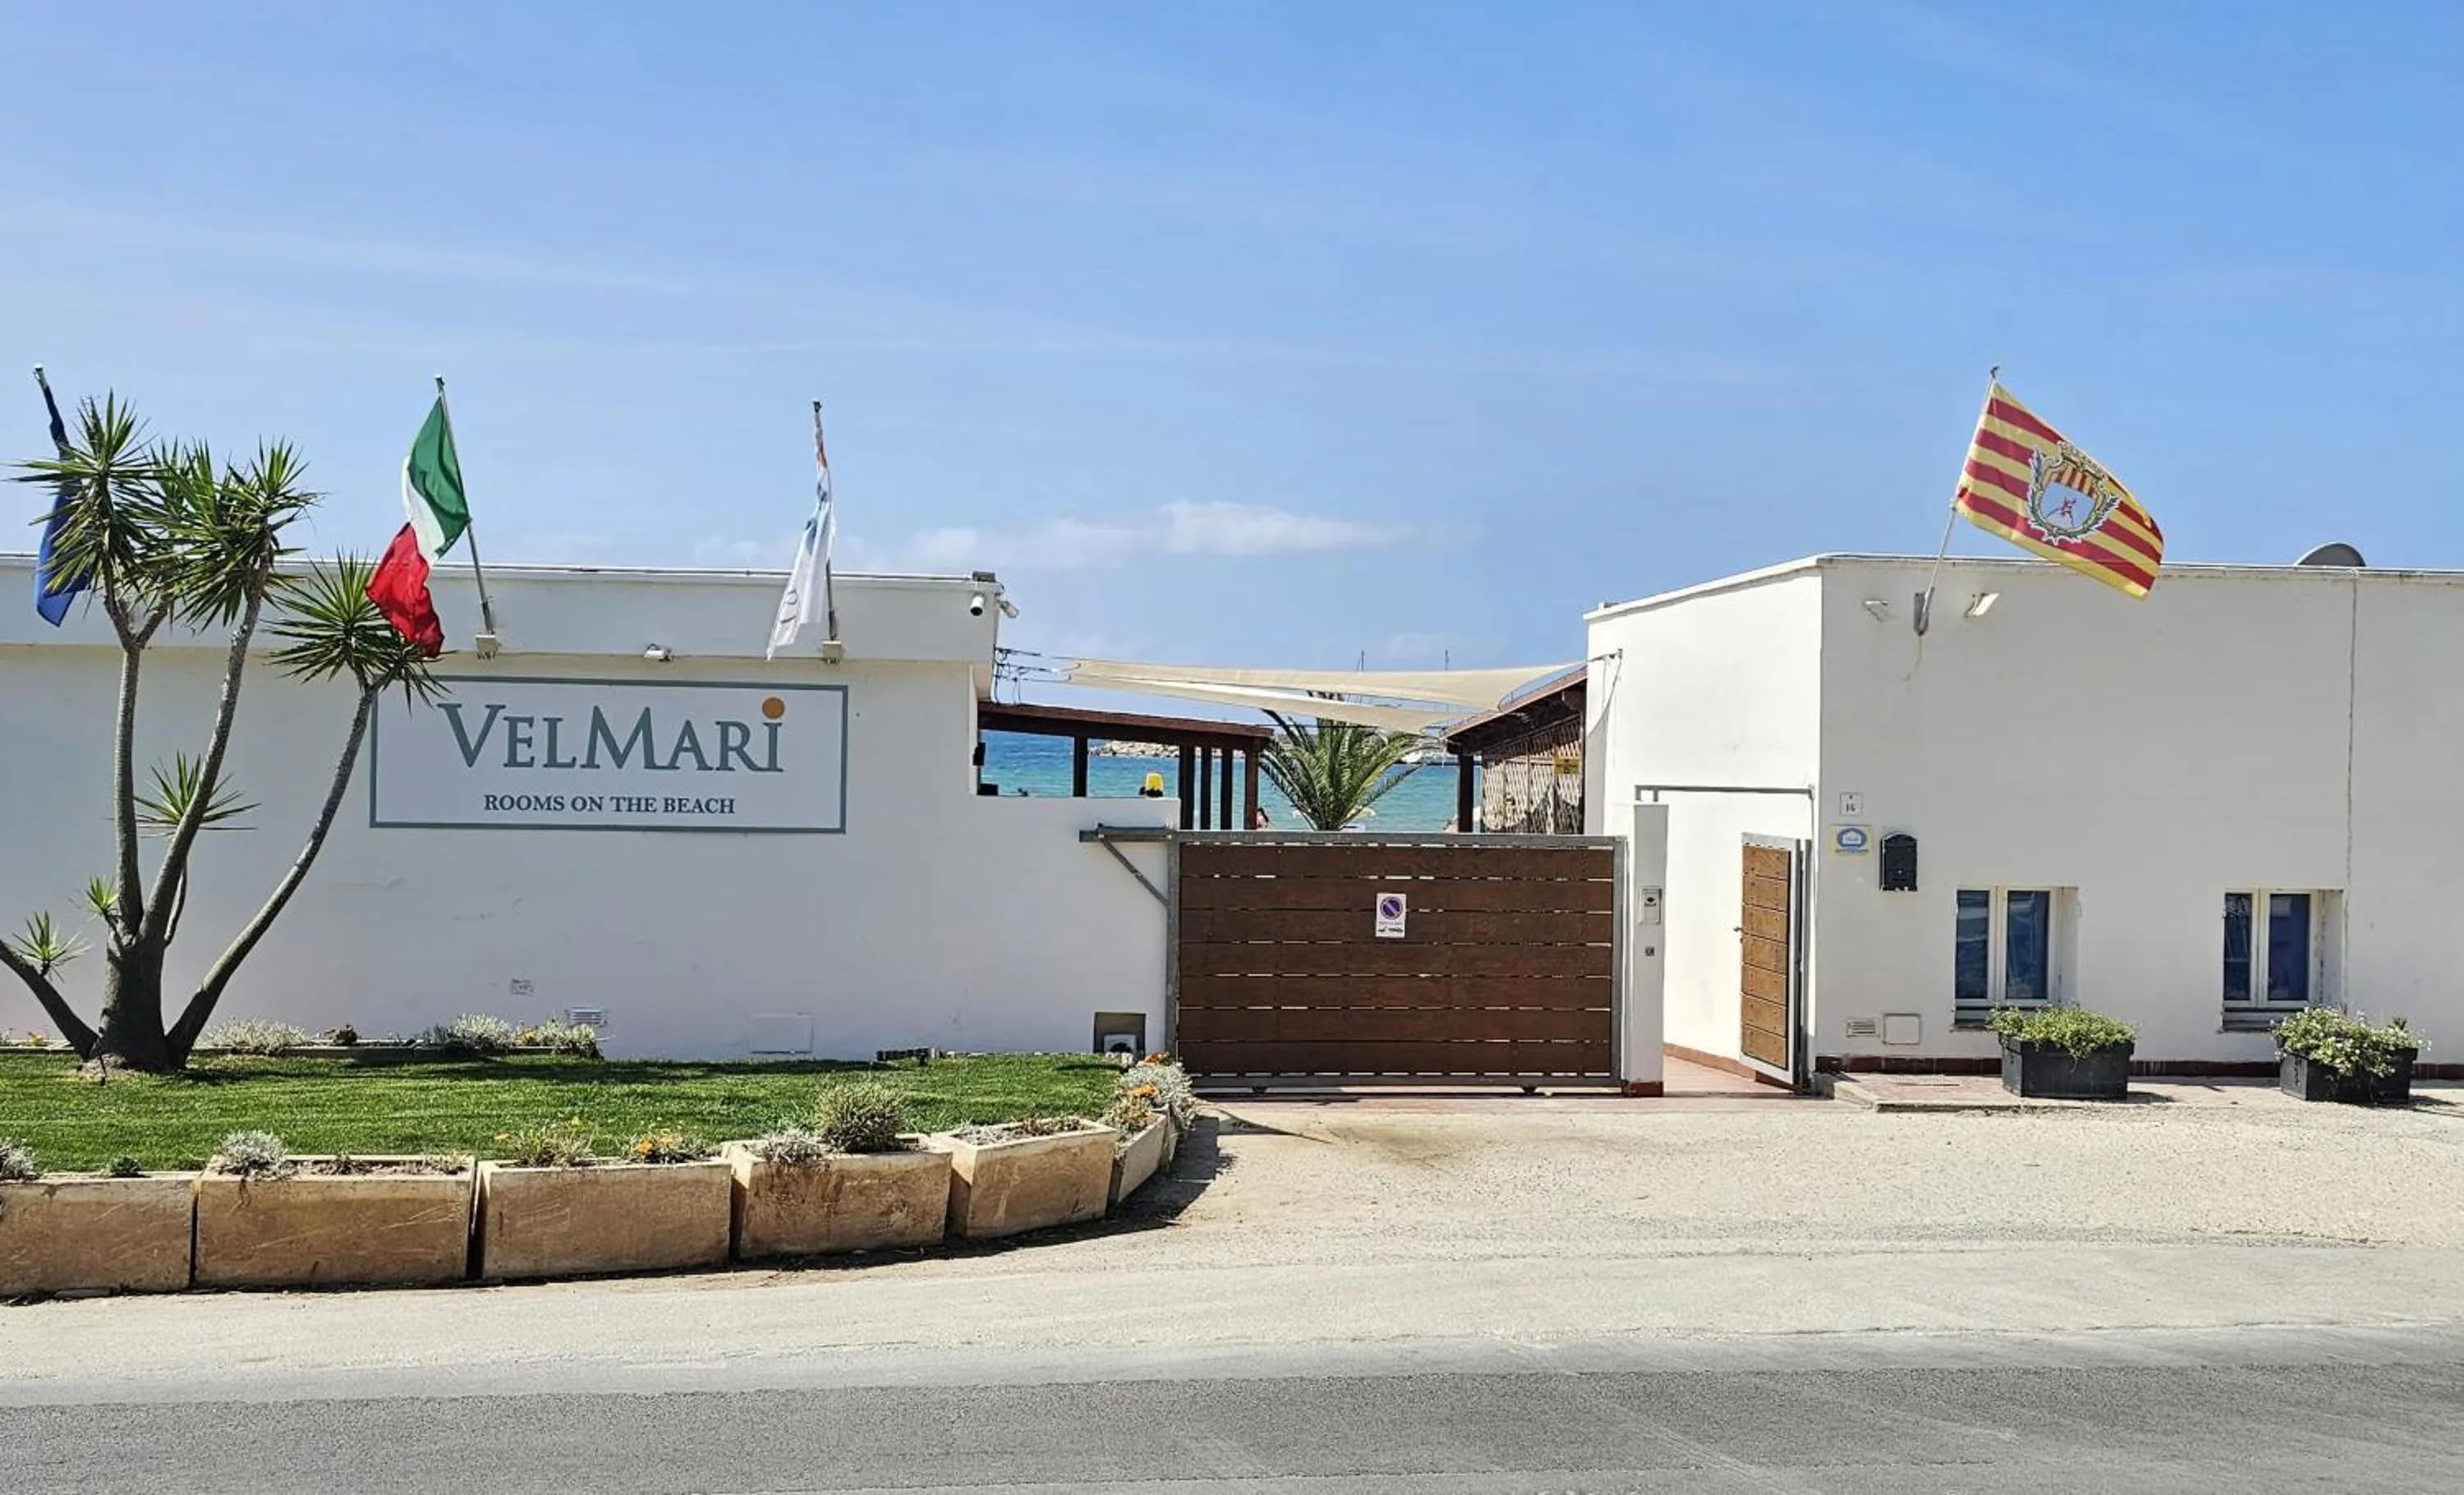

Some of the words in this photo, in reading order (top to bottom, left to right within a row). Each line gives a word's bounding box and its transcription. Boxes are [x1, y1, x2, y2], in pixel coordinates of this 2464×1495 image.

[484, 794, 565, 812] ROOMS
[570, 796, 605, 812] ON
[609, 796, 658, 813] THE
[663, 797, 735, 814] BEACH
